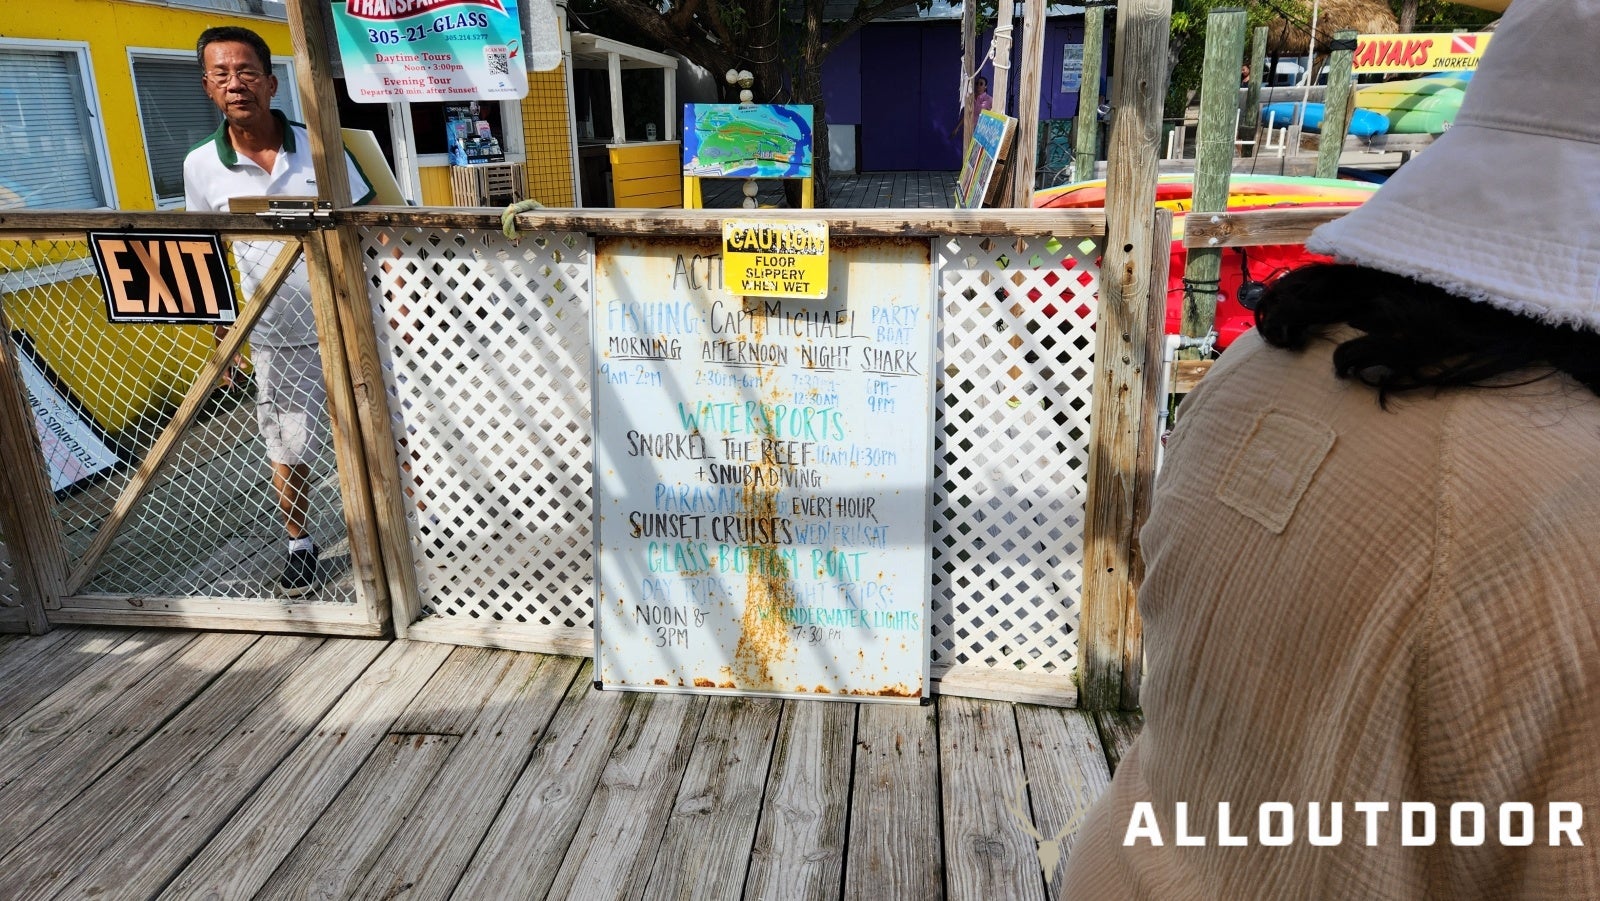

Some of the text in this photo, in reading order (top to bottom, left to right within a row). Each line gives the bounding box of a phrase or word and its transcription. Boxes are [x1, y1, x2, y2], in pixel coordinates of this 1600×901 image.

[368, 12, 488, 44] 305-21-GLASS
[375, 52, 451, 64] Daytime Tours
[1353, 39, 1433, 69] KAYAKS
[433, 63, 463, 72] 3:00pm
[360, 88, 392, 97] Departs
[426, 86, 445, 94] after
[448, 86, 478, 94] Sunset!
[384, 76, 451, 88] Evening Tour
[729, 226, 822, 251] CAUTION
[755, 256, 795, 267] FLOOR
[98, 239, 219, 314] EXIT
[746, 268, 805, 280] SLIPPERY
[742, 279, 810, 292] WHEN WET
[872, 305, 919, 326] PARTY
[877, 326, 914, 344] BOAT
[609, 336, 921, 375] MORNING AFTERNOON NIGHT SHARK
[868, 396, 895, 414] 9PM
[626, 430, 716, 461] SNORKEL
[722, 438, 757, 462] THE
[761, 438, 815, 467] REEF
[770, 467, 822, 488] DIVING
[792, 496, 833, 518] EVERY
[838, 496, 878, 523] HOUR
[629, 511, 706, 539] SUNSET
[712, 515, 792, 545] CRUISES
[648, 541, 868, 582] GLASS BOTTOM BOAT
[642, 578, 672, 601] DAY
[636, 605, 711, 628] NOON &
[780, 607, 870, 630] UNDERWATER
[874, 610, 919, 631] LIGHTS
[656, 627, 688, 649] 3PM
[793, 625, 841, 643] 7:30 PM
